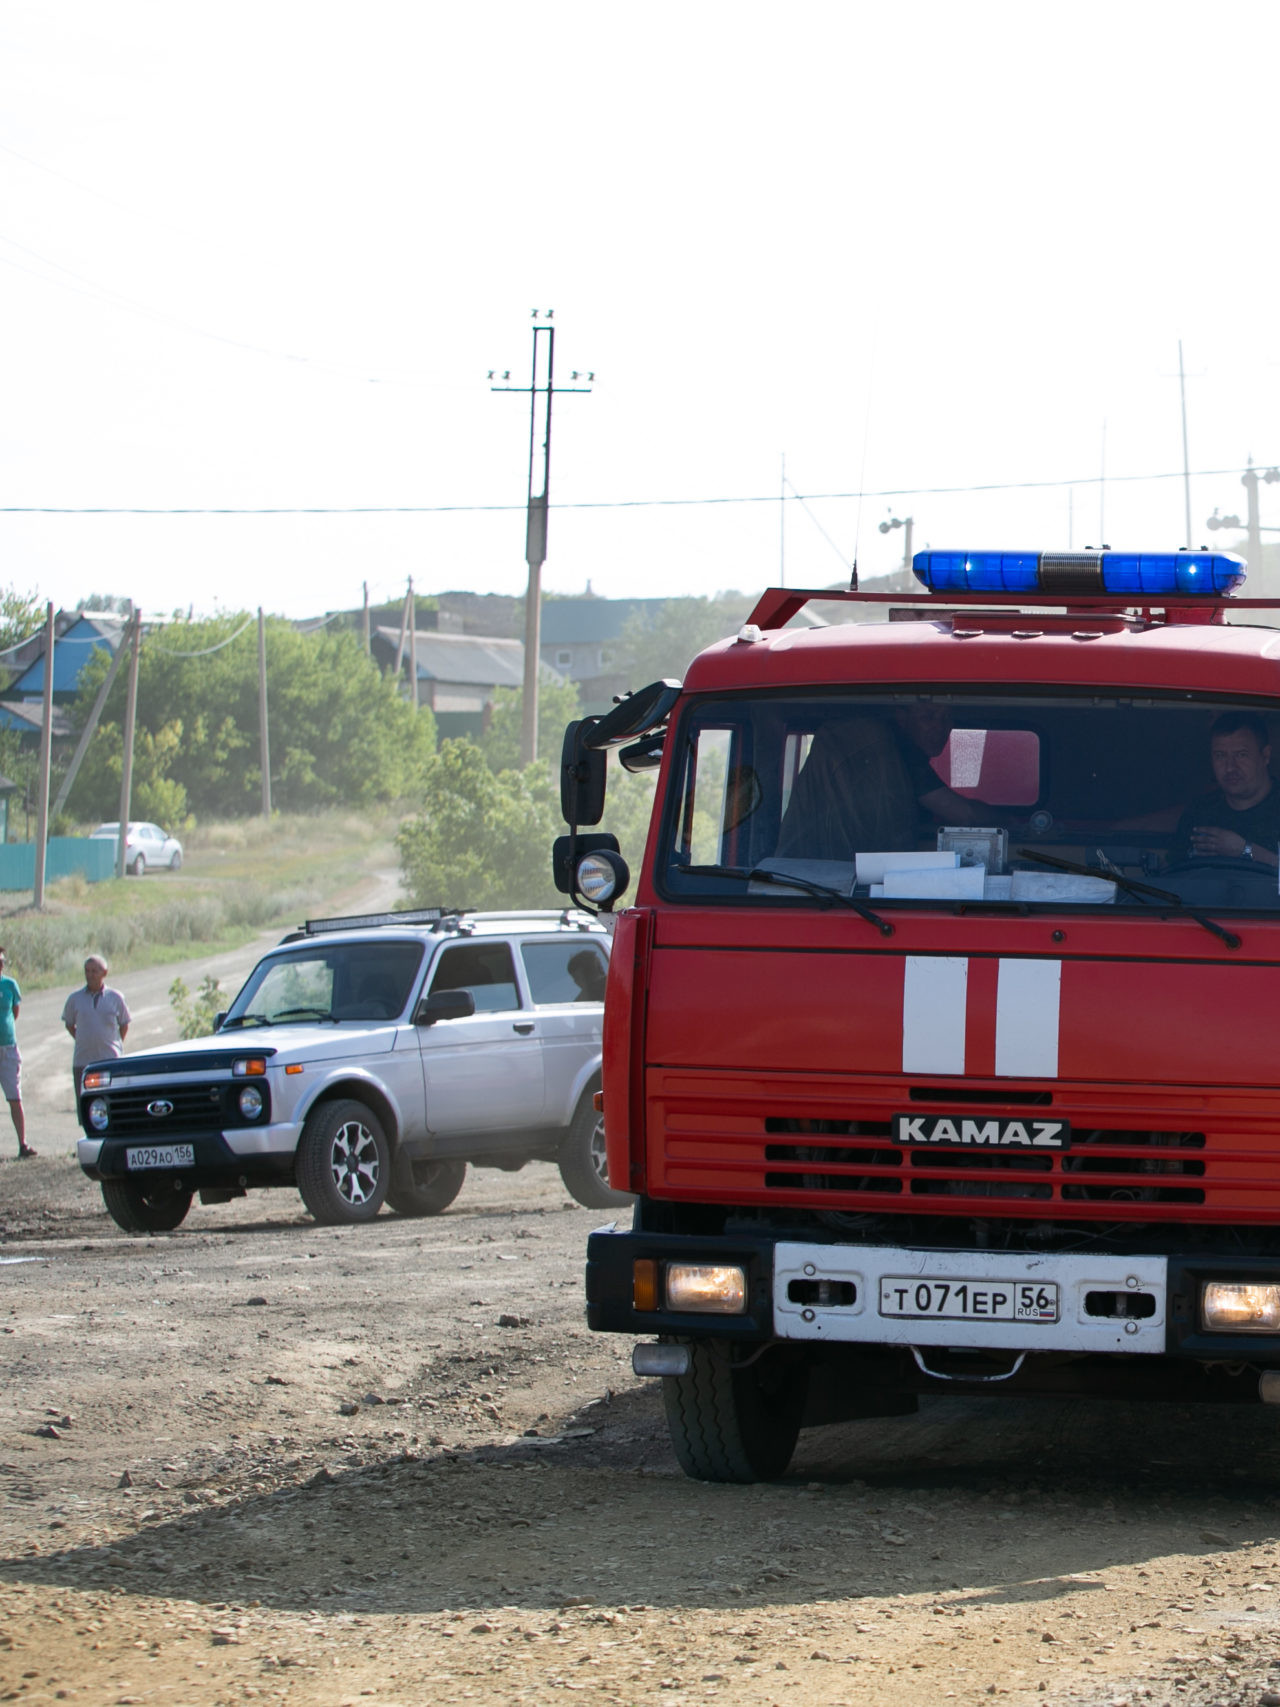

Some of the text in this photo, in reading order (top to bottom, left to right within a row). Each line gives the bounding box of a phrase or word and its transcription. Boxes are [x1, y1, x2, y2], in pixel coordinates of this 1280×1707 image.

[899, 1117, 1063, 1147] KAMAZ
[174, 1146, 192, 1159] 156
[1021, 1287, 1049, 1309] 56
[1017, 1307, 1039, 1317] RUS
